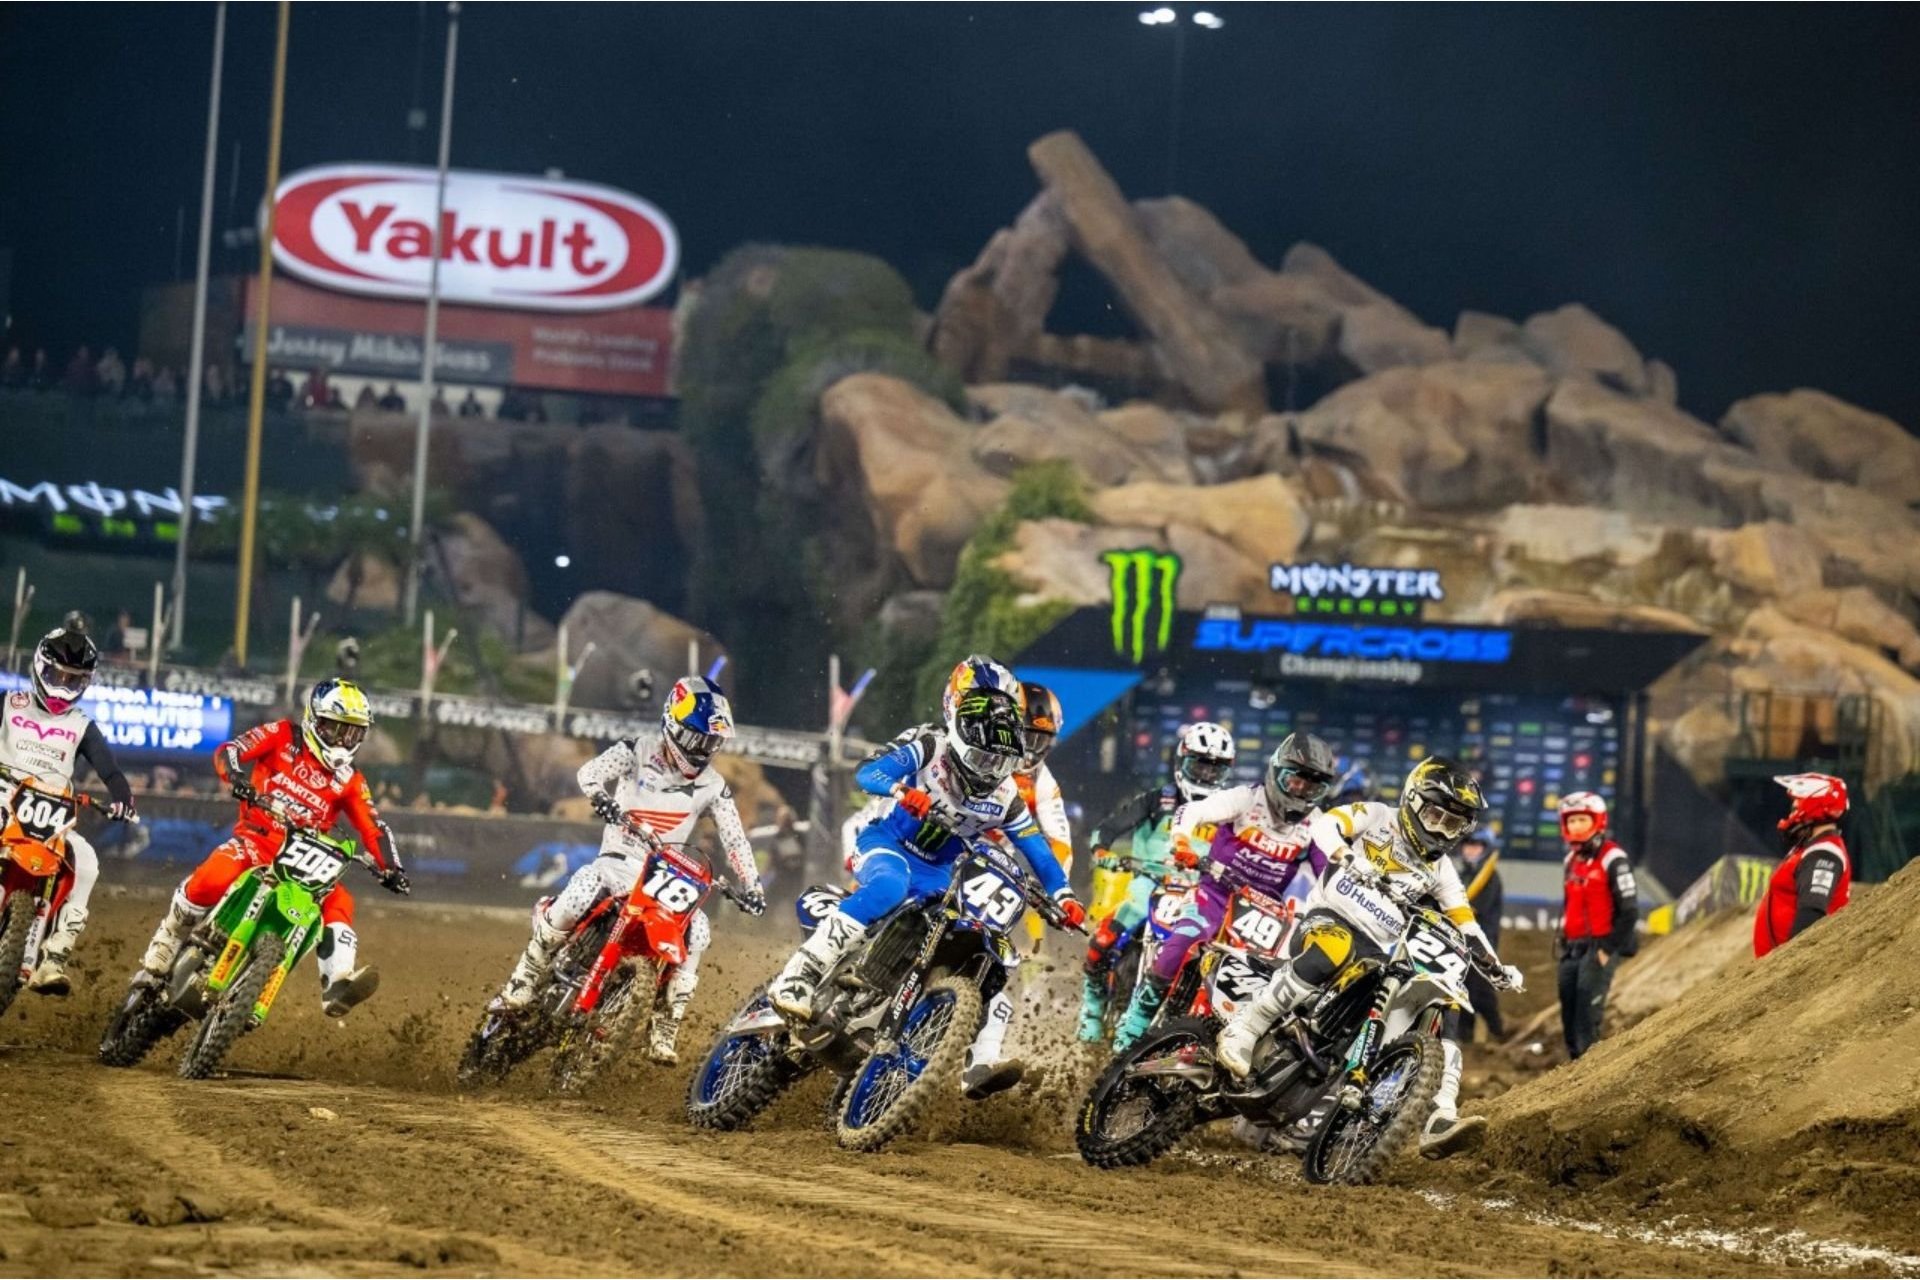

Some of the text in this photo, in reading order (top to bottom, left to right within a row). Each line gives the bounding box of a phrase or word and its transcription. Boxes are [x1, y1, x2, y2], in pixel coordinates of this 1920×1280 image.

[338, 200, 613, 277] Yakult
[1271, 562, 1444, 600] MONSTER
[1193, 618, 1513, 664] SUPERCROSS
[1280, 653, 1423, 684] Championship
[161, 726, 203, 749] LAP
[17, 792, 68, 834] 604
[278, 840, 344, 883] 508
[1249, 831, 1298, 860] LEATT
[641, 869, 700, 913] 18
[963, 872, 1022, 925] 43
[1350, 888, 1402, 933] Husqvarn
[1232, 909, 1282, 951] 49
[1407, 931, 1469, 988] 24
